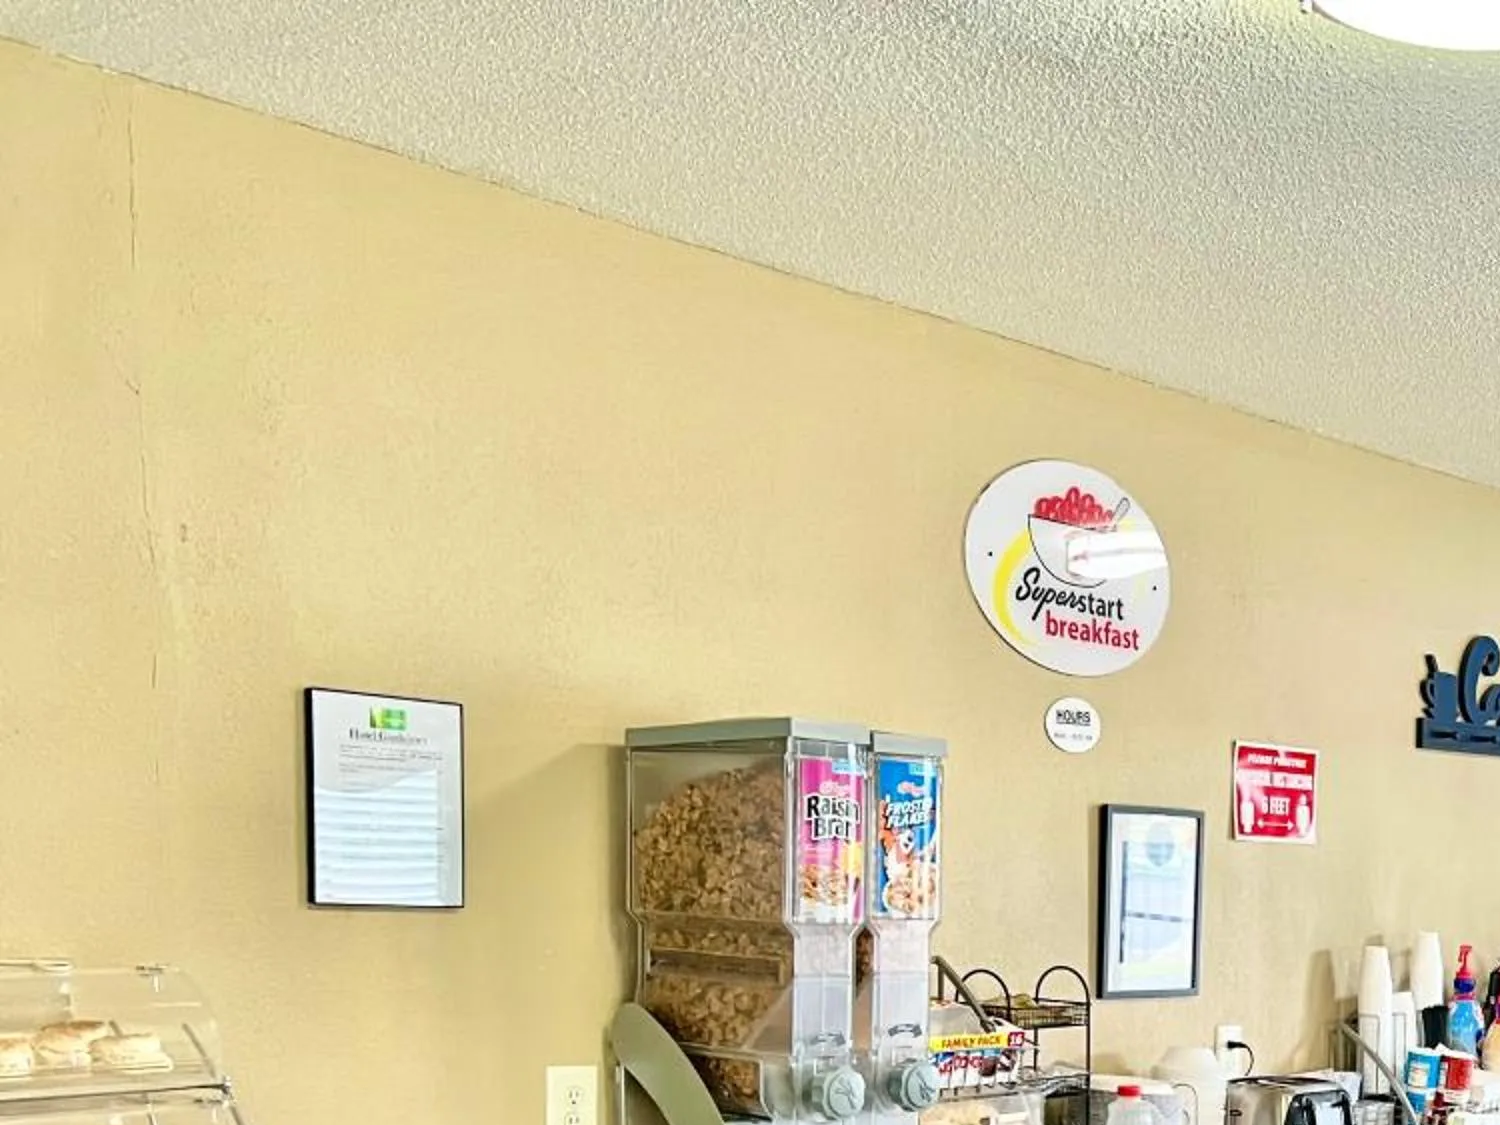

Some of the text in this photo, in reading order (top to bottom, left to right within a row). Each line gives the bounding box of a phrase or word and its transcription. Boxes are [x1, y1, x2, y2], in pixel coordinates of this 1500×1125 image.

[1015, 566, 1125, 621] Superstart
[1045, 610, 1140, 651] breakfast
[1055, 709, 1091, 724] HOURS
[806, 795, 860, 822] Raisin
[941, 1037, 975, 1049] FAMILY
